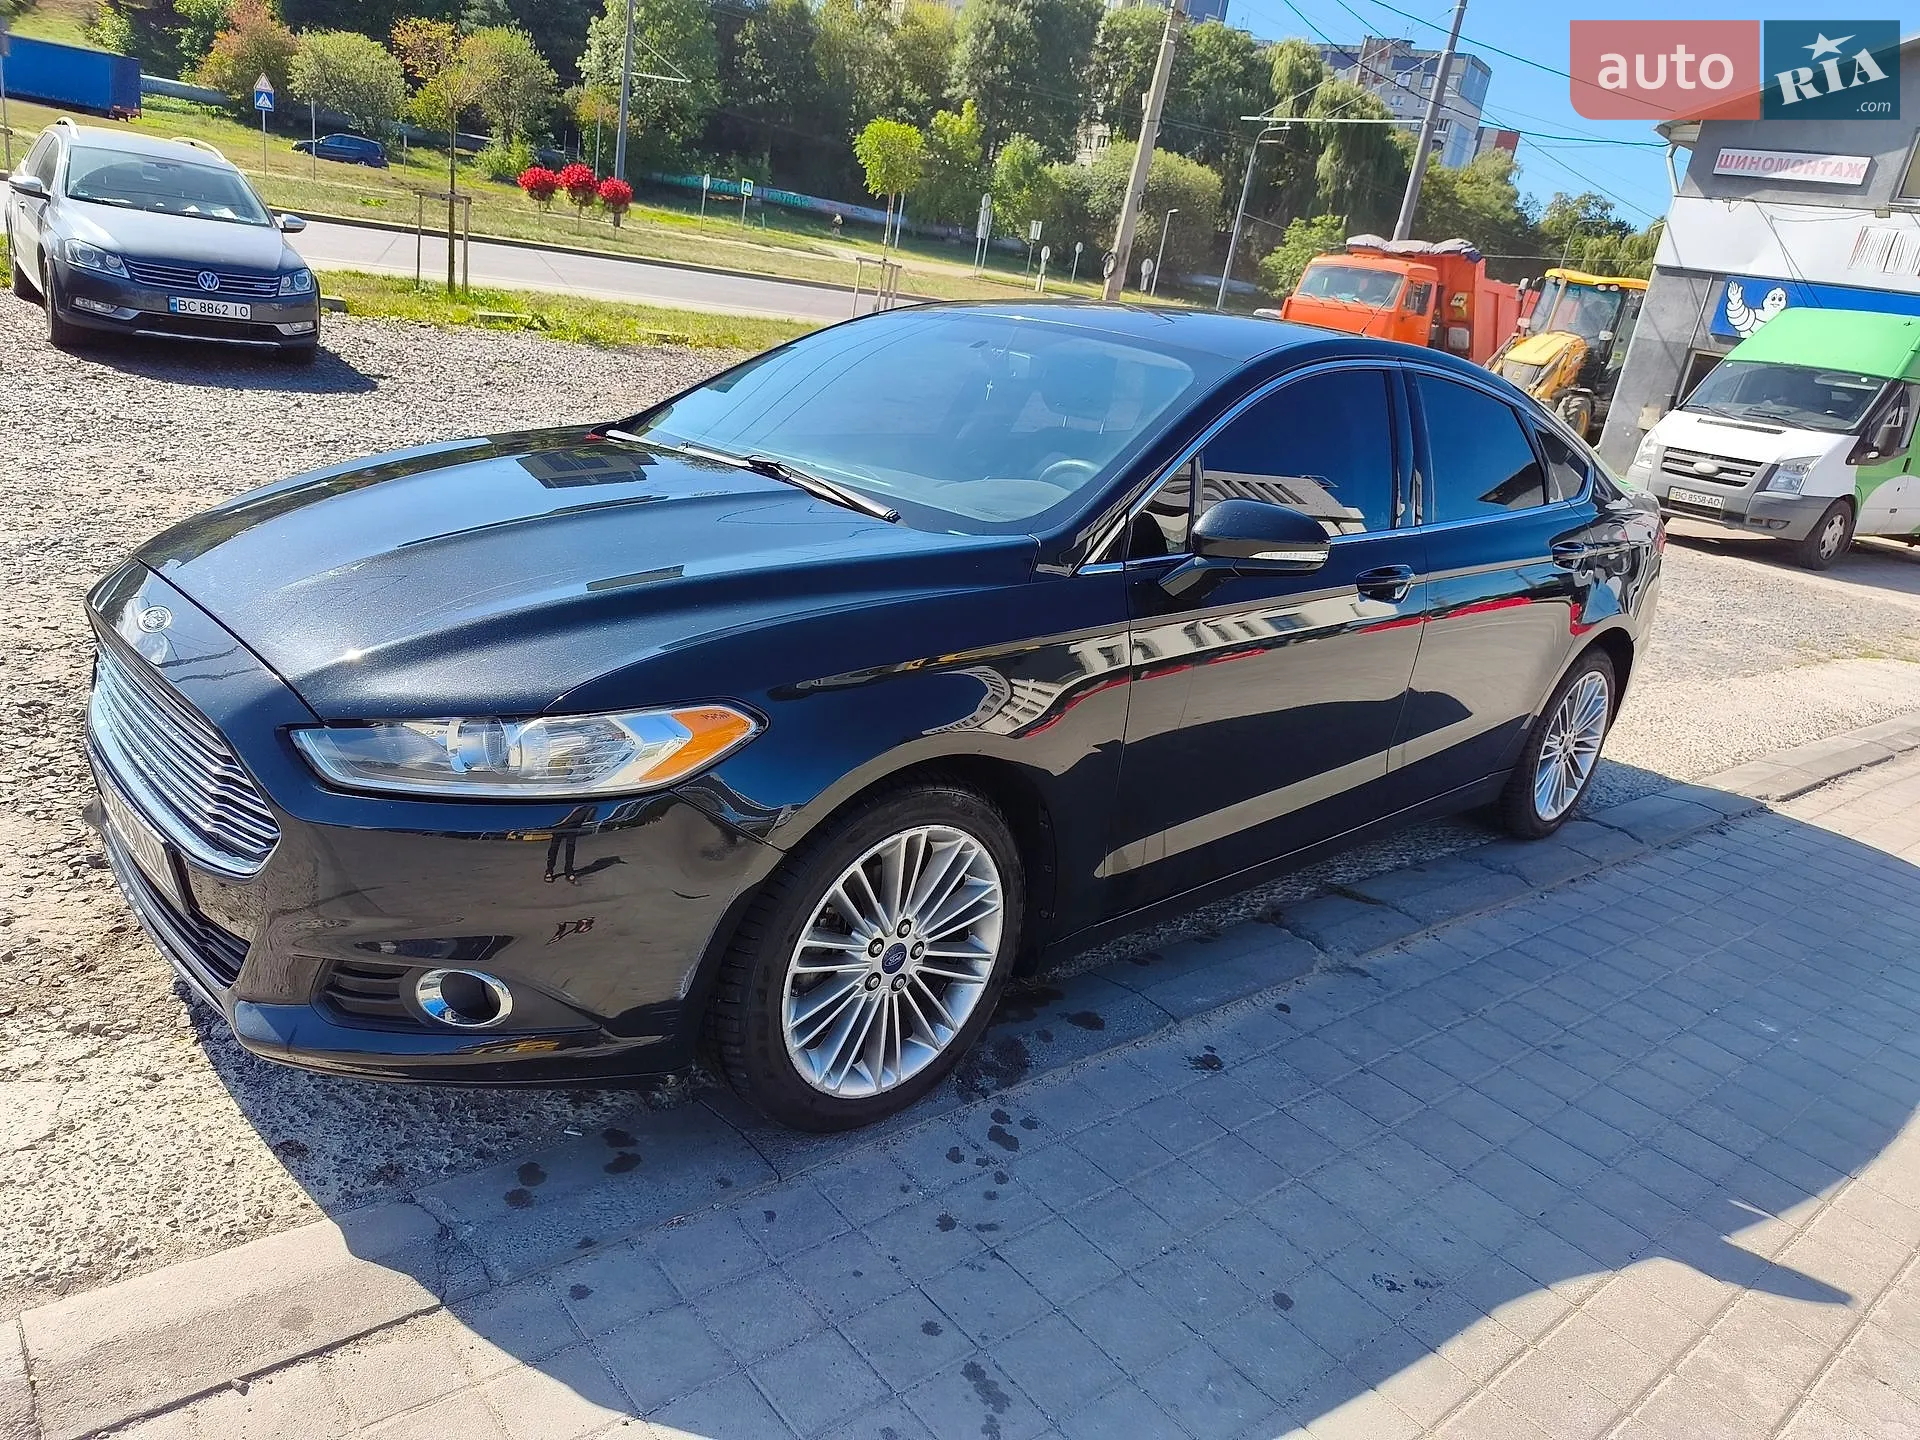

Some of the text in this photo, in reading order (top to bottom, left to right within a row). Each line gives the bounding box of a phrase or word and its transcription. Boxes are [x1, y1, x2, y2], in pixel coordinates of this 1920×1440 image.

[1718, 153, 1866, 179] ШИНОМОНТАЖ
[178, 299, 197, 312] BC
[200, 302, 229, 316] 8862
